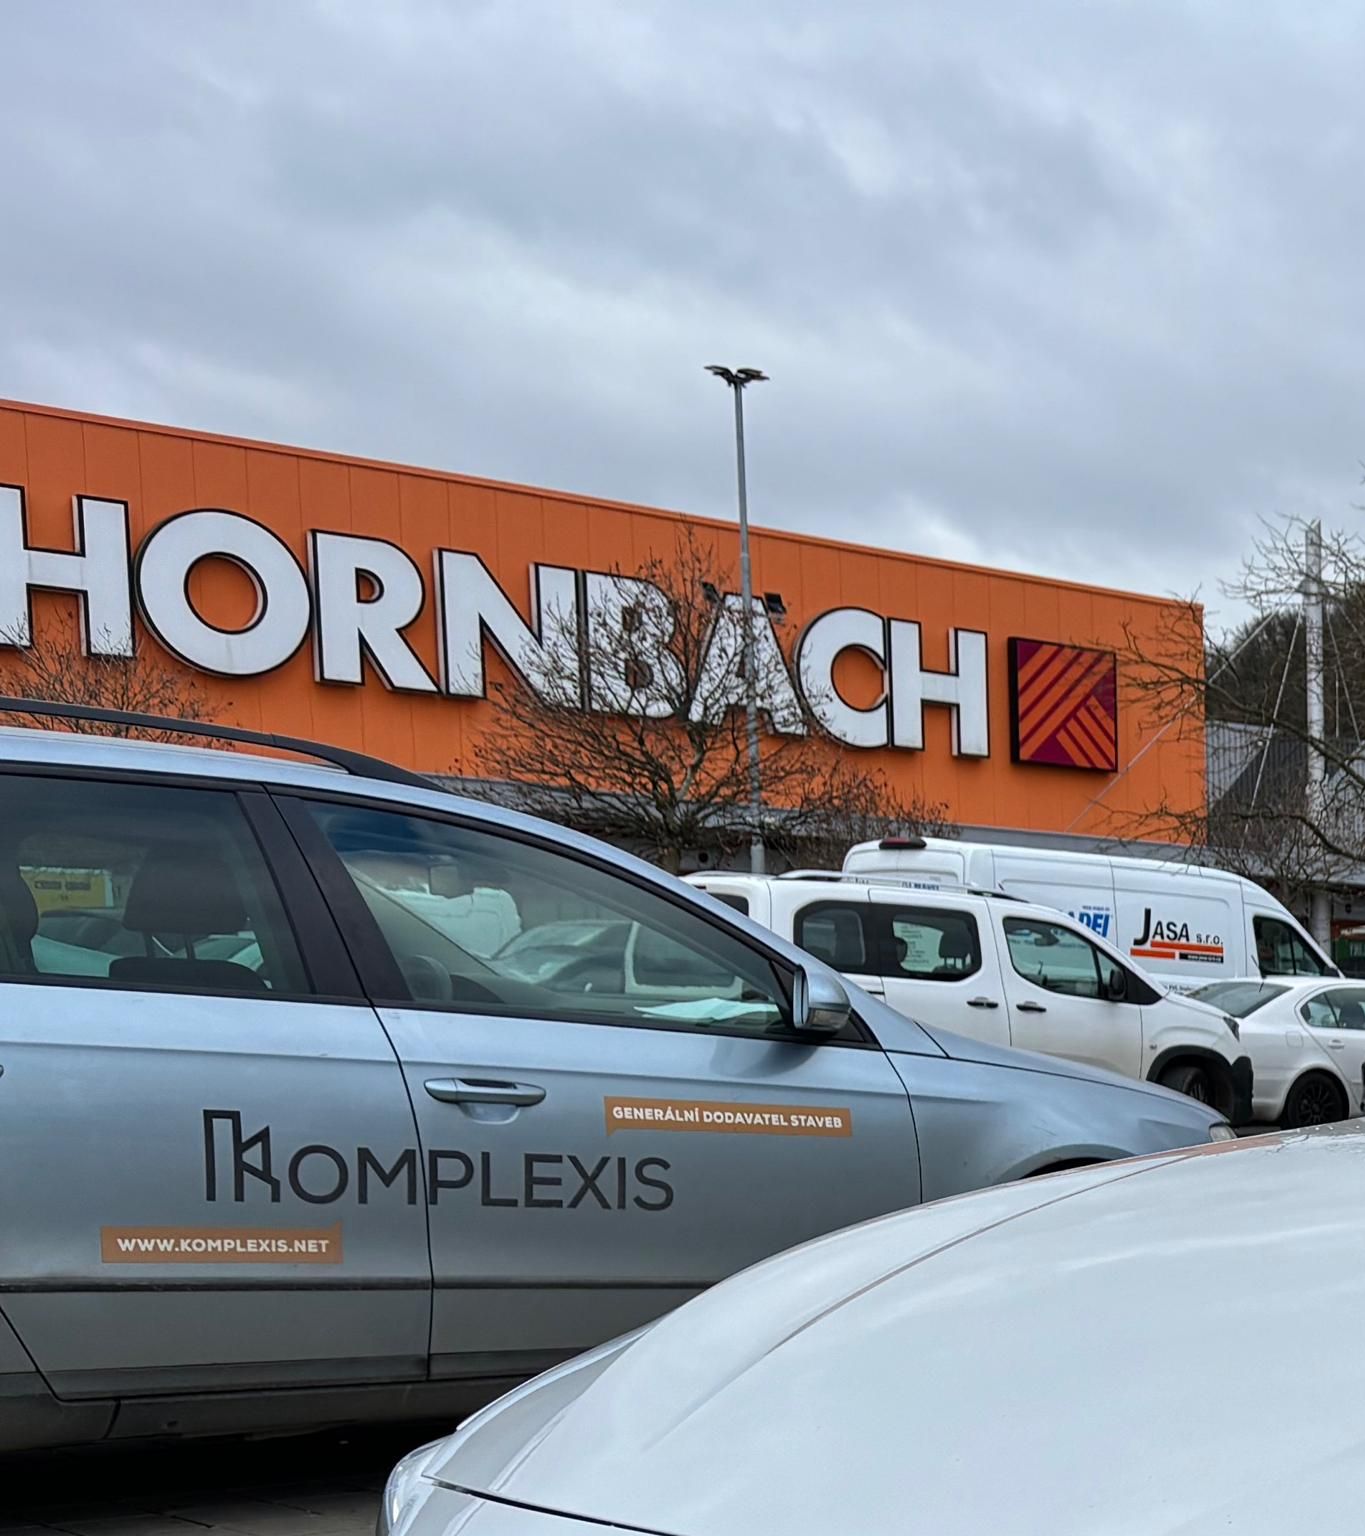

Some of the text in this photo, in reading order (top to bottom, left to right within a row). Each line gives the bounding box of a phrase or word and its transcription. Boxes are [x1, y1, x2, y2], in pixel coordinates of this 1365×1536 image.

[0, 483, 990, 760] HORNBACH
[1133, 908, 1224, 946] JASA s.r.o.
[612, 1105, 842, 1129] GENERÁLNÍ DODAVATEL STAVEB
[116, 1236, 330, 1254] WWW.KOMPLEXIS.NET
